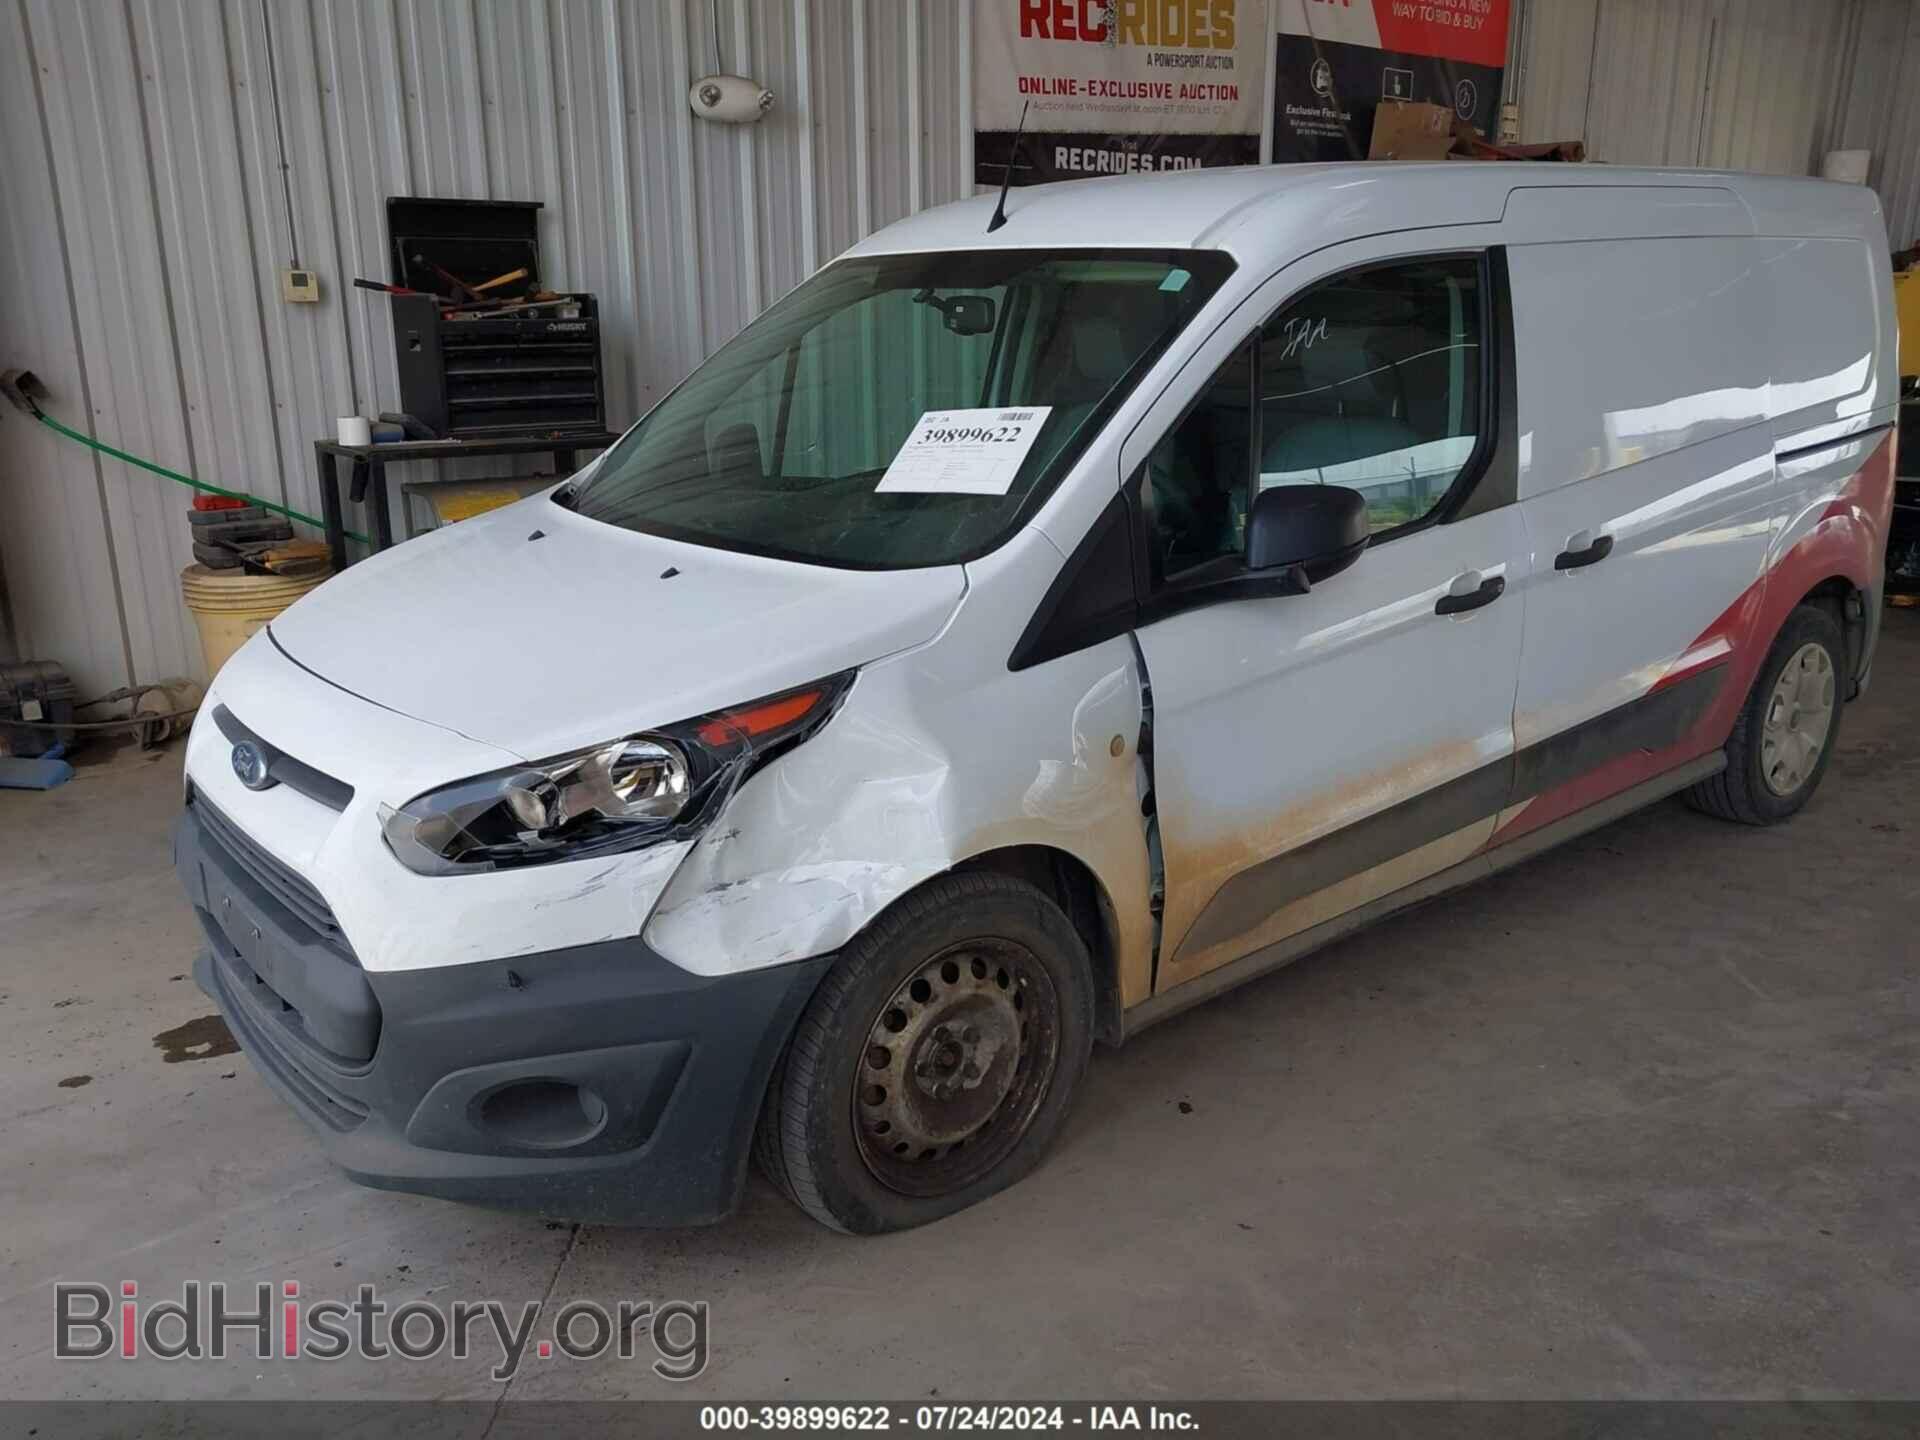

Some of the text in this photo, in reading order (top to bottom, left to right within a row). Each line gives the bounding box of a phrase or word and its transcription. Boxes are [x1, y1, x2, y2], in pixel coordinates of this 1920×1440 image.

[1392, 2, 1417, 19] WAY
[1420, 5, 1434, 21] TO
[1453, 13, 1462, 27] &
[1464, 14, 1484, 30] BUY
[1146, 53, 1234, 70] A POWERSPORT AUCTION
[1018, 77, 1239, 101] ONLINE-EXCLUSIVE AUCTION
[916, 427, 1022, 446] 39899622
